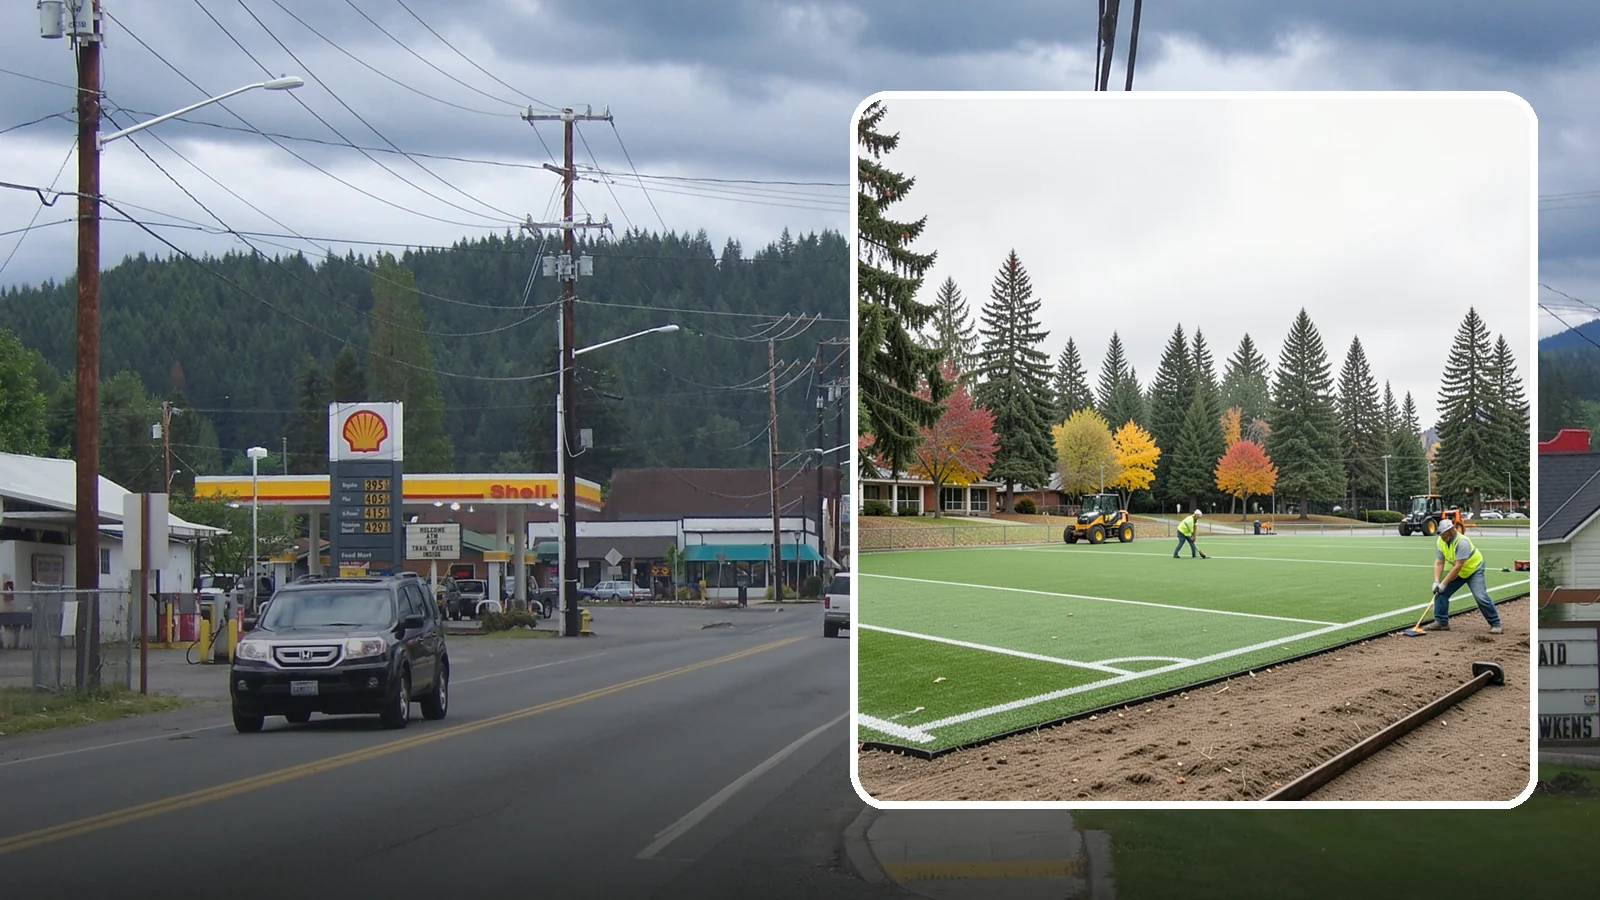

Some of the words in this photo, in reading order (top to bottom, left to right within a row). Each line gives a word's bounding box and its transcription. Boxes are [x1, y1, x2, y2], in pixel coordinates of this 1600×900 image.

[366, 480, 383, 490] 395
[490, 484, 547, 499] Shell
[366, 494, 383, 504] 405
[366, 508, 383, 518] 415
[366, 522, 383, 532] 429
